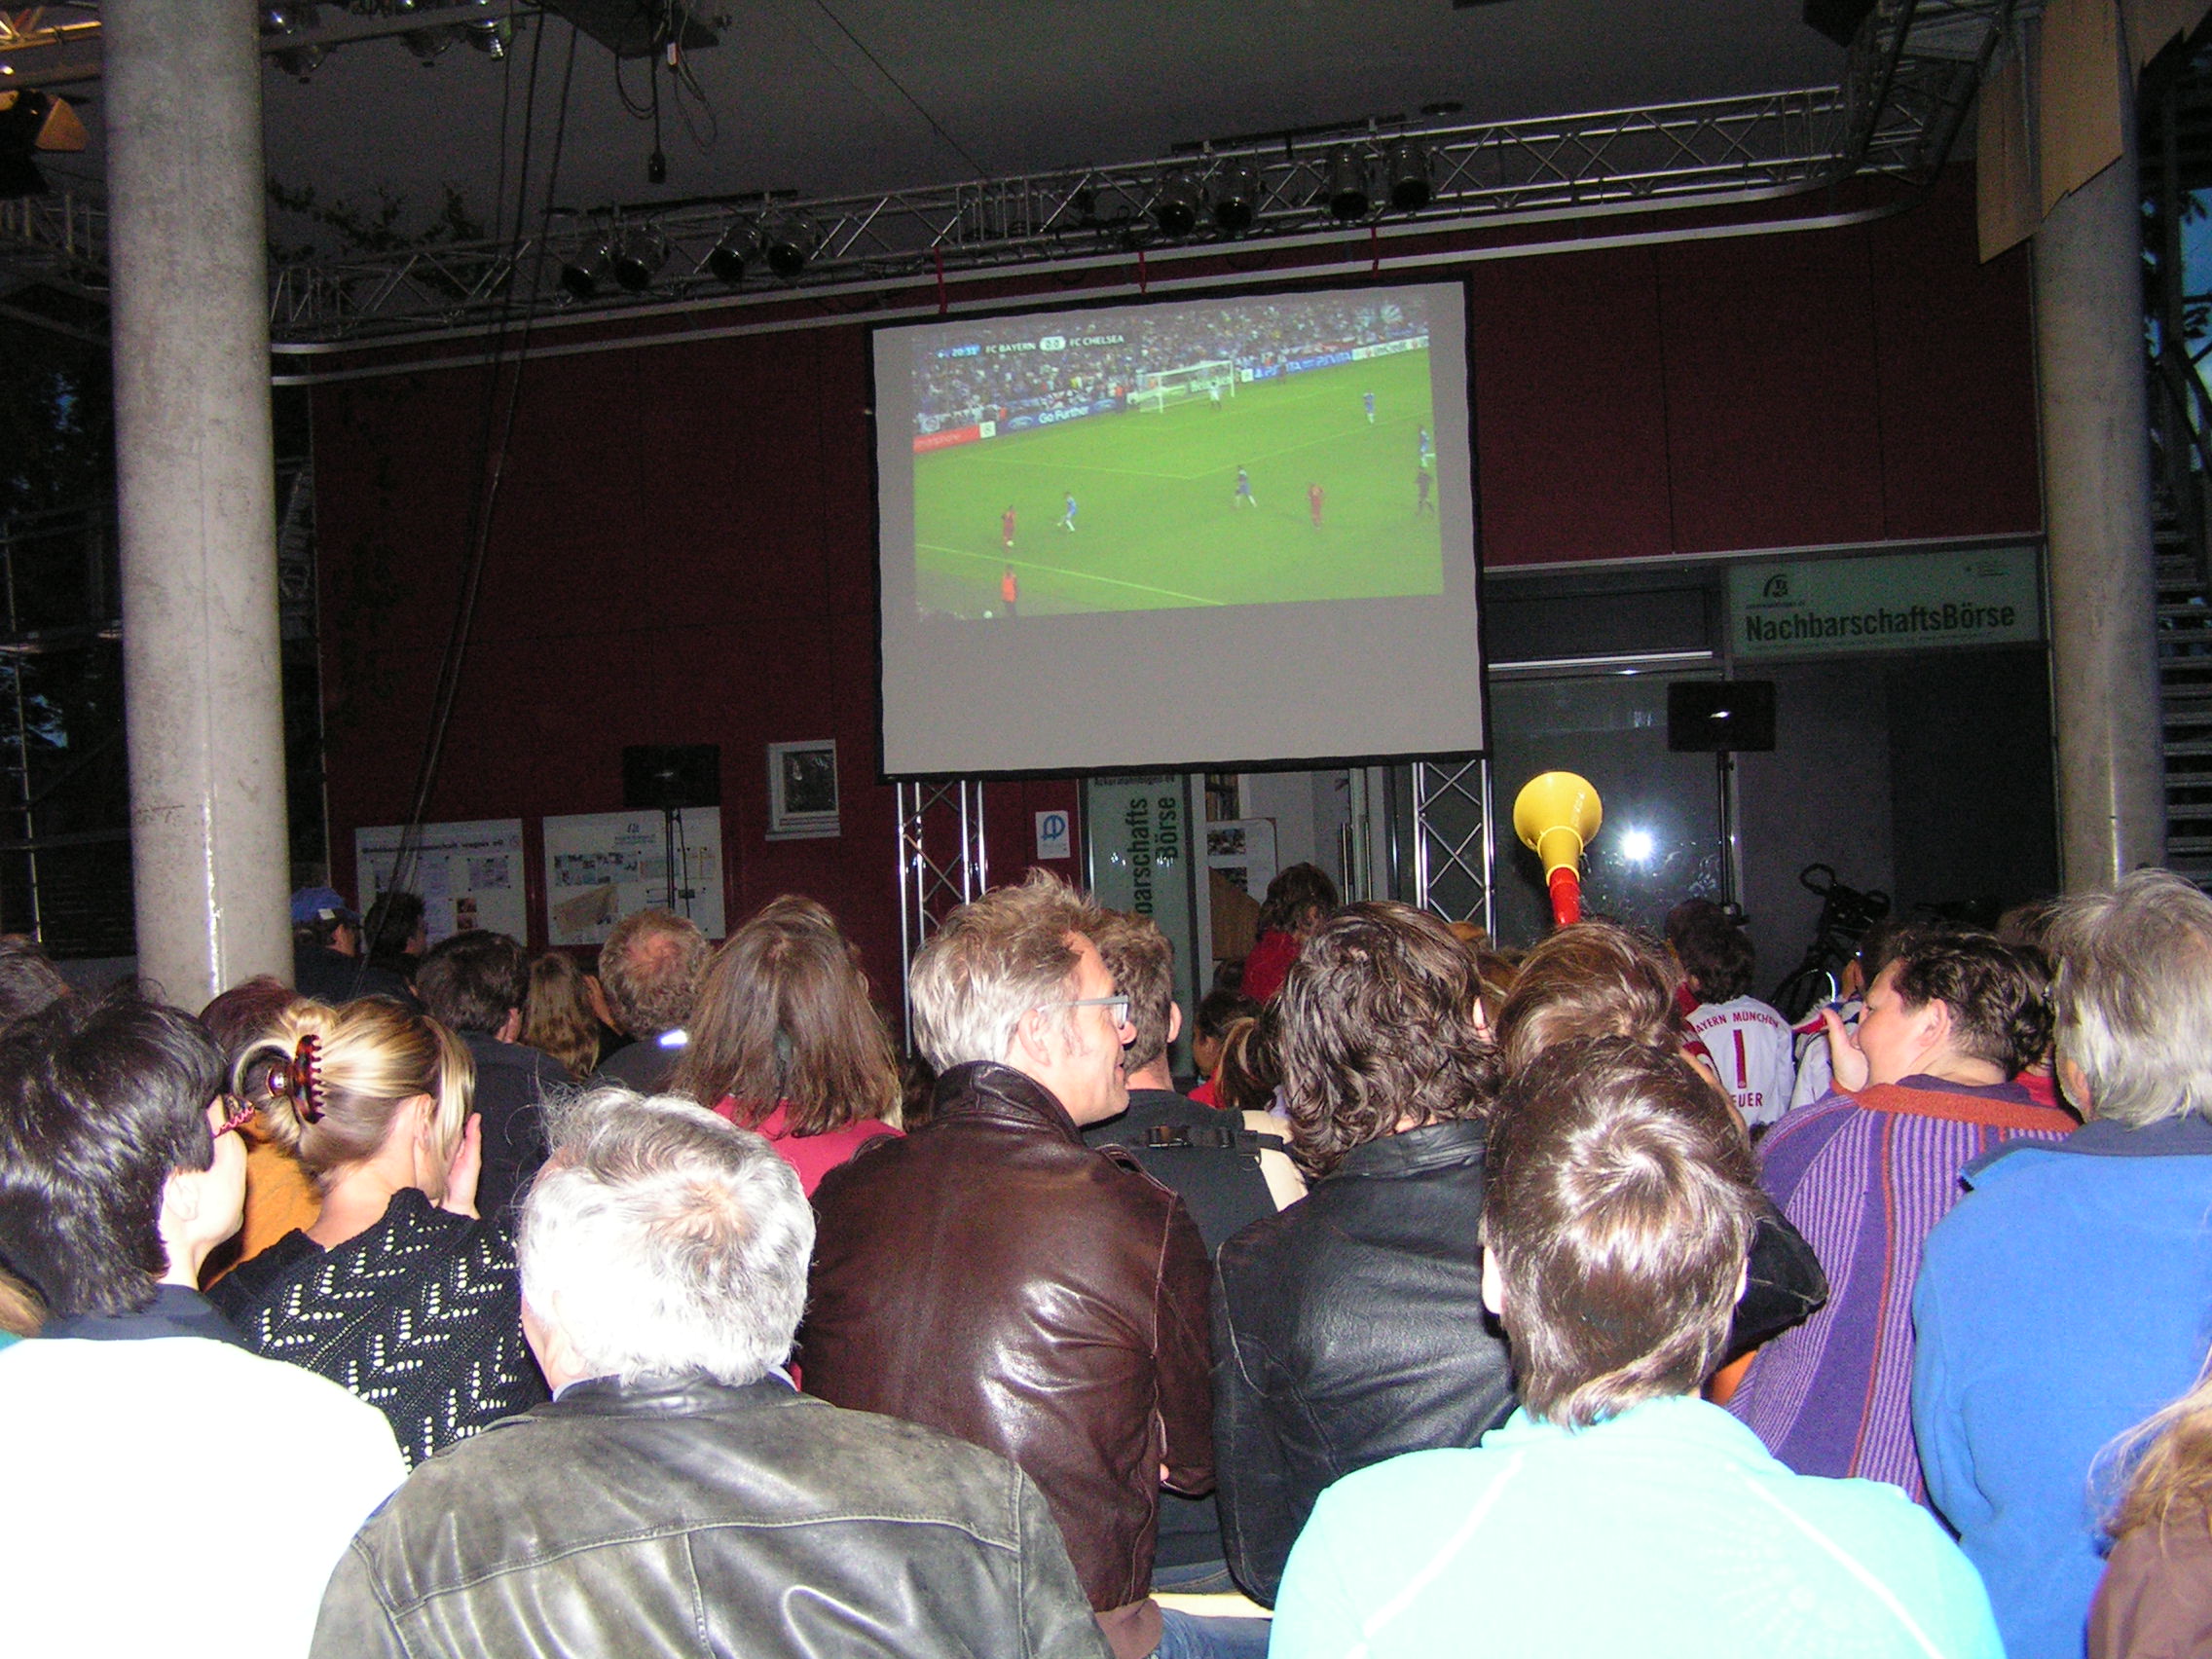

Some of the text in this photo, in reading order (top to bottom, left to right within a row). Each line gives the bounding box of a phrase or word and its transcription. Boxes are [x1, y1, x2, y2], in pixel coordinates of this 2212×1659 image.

[985, 345, 997, 354] FC
[998, 343, 1037, 352] BAYERN
[1069, 338, 1082, 348] FC
[1083, 334, 1125, 346] CHELSEA
[1039, 412, 1053, 424] Go
[1746, 602, 2015, 642] NachbarschaftsBörse
[1154, 796, 1179, 858] Börse
[1695, 1012, 1779, 1033] AYERN MÜNCHEN
[1733, 1029, 1748, 1089] 1
[1729, 1092, 1763, 1108] EUER
